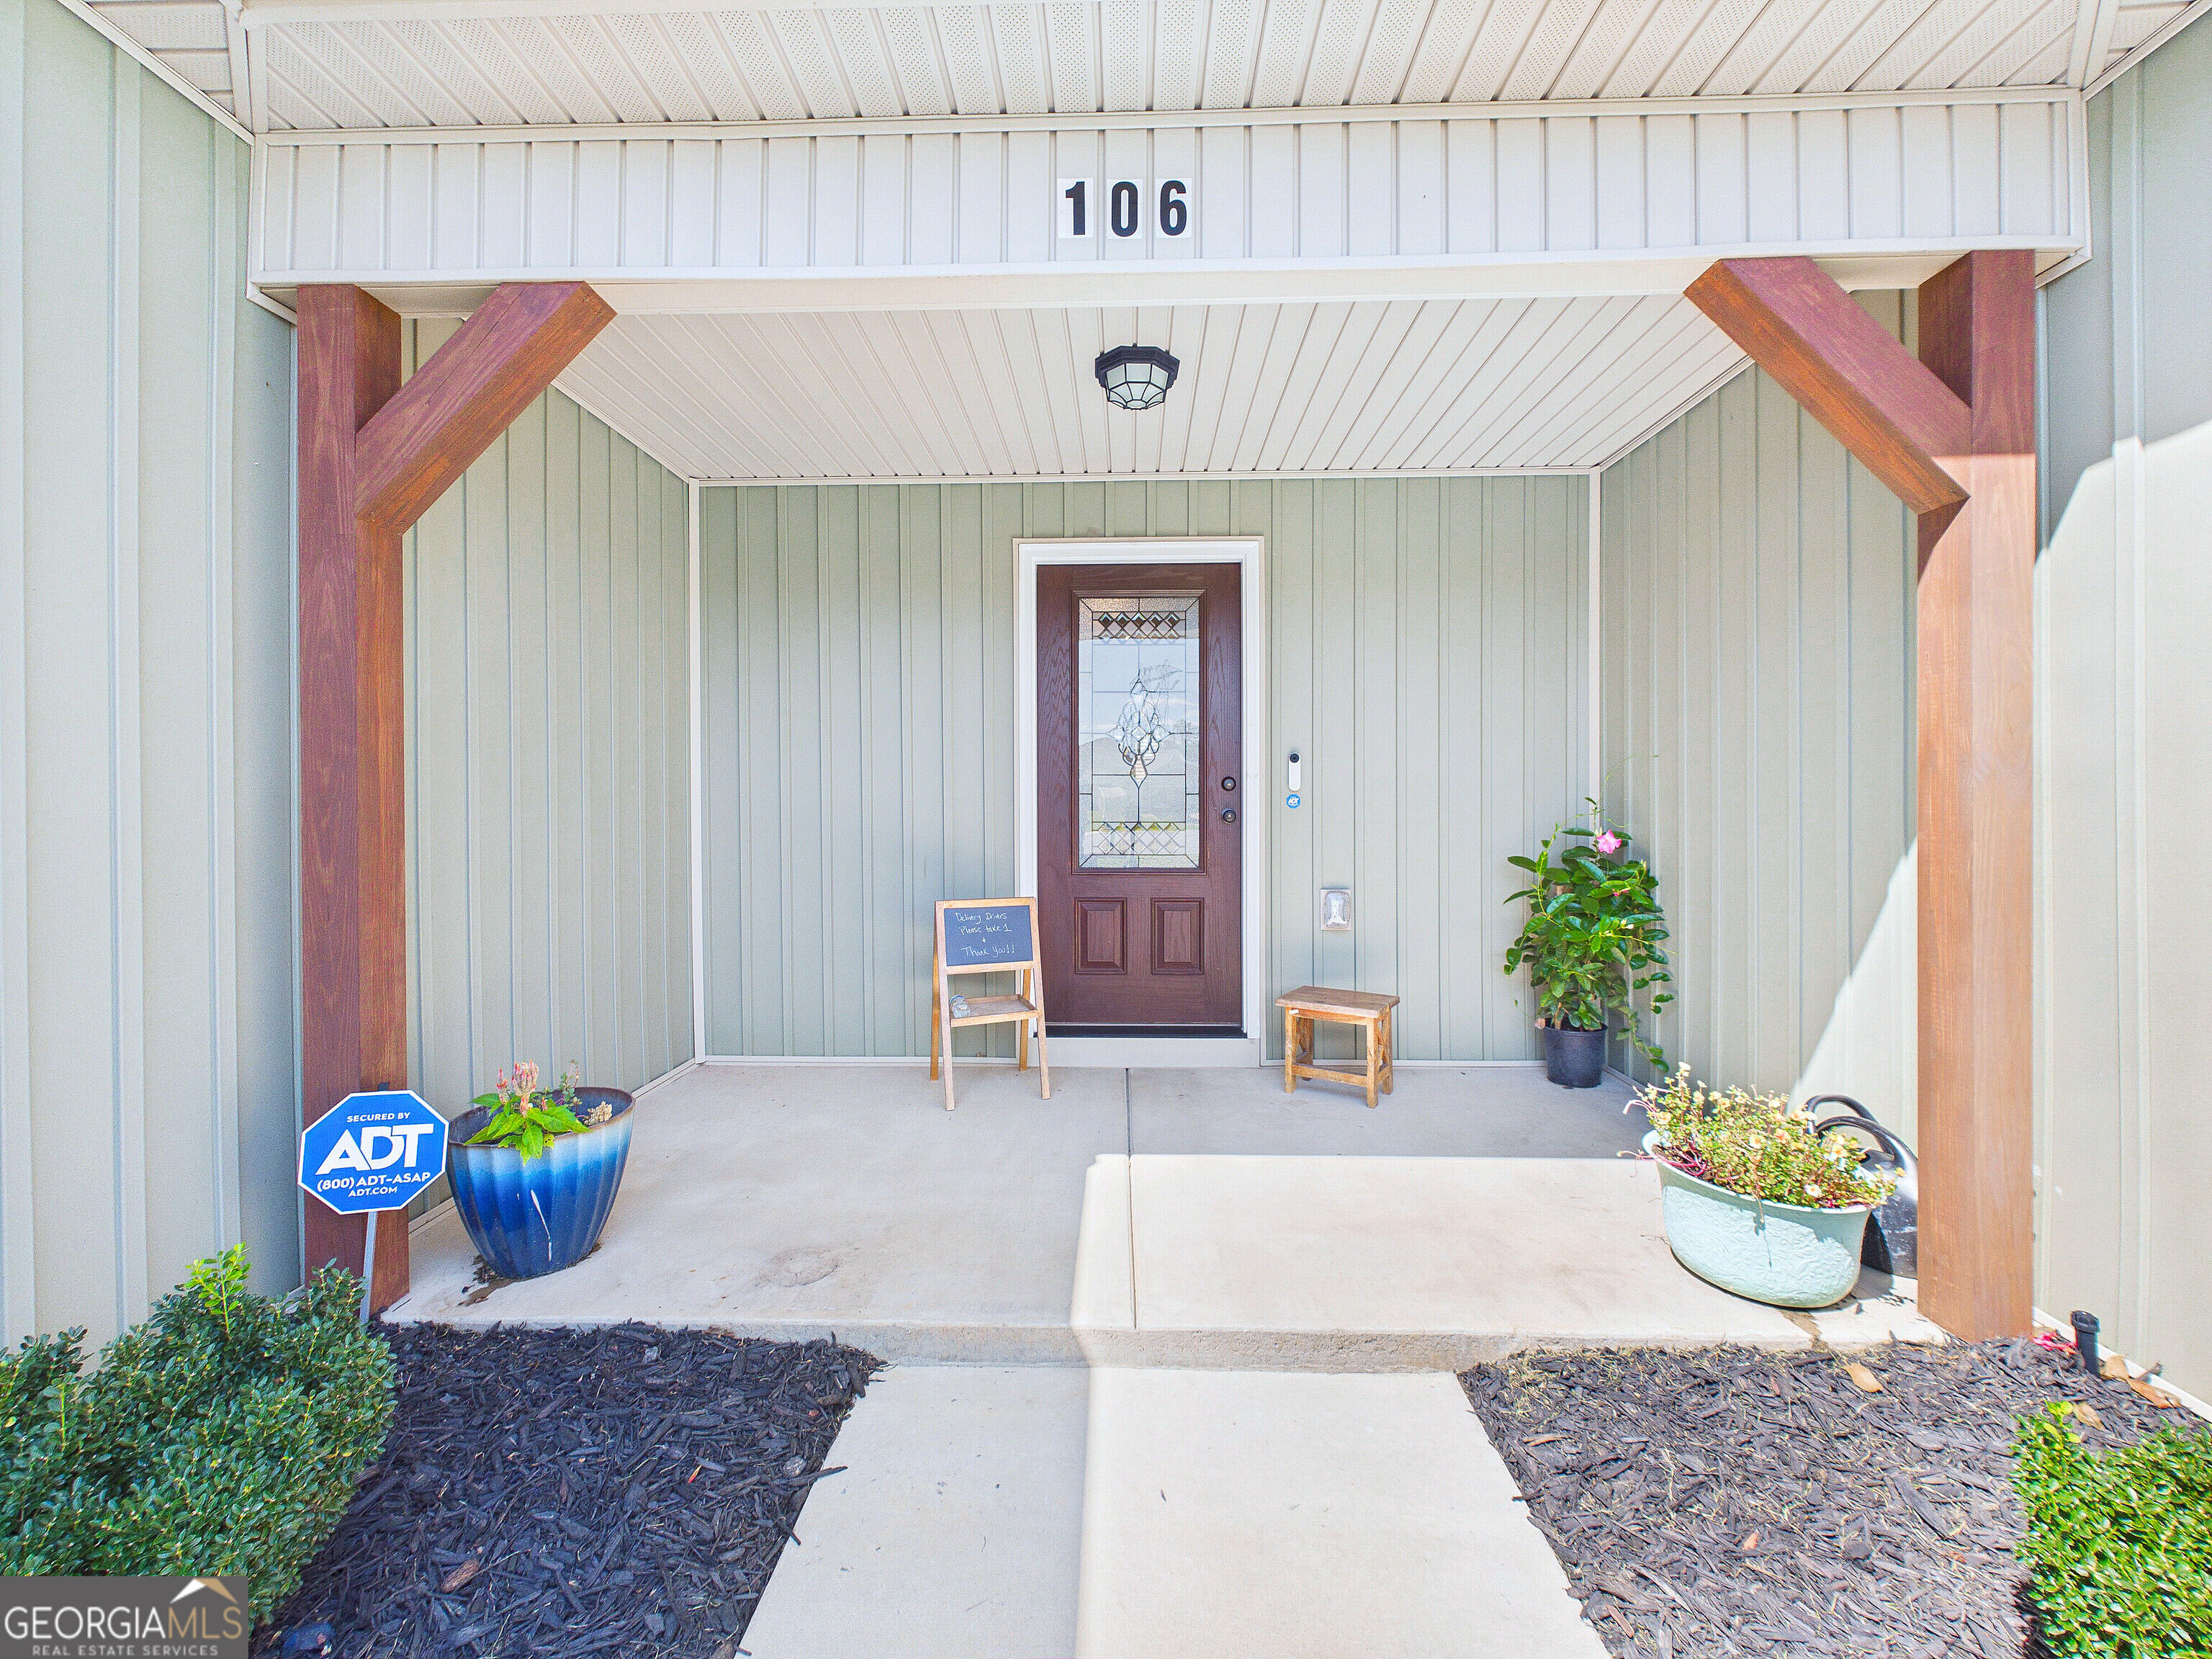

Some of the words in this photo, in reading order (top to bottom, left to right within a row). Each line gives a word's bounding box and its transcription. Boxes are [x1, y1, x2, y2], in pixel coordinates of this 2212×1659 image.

[1065, 180, 1187, 238] 106
[956, 912, 981, 924] Delivery
[958, 925, 981, 935] Please
[961, 946, 989, 957] Thank
[346, 1114, 395, 1123] SECURED
[315, 1123, 434, 1175] ADT
[317, 1177, 355, 1192] (800)
[356, 1172, 431, 1187] ADT-ASAP
[348, 1186, 397, 1197] ADT.COM
